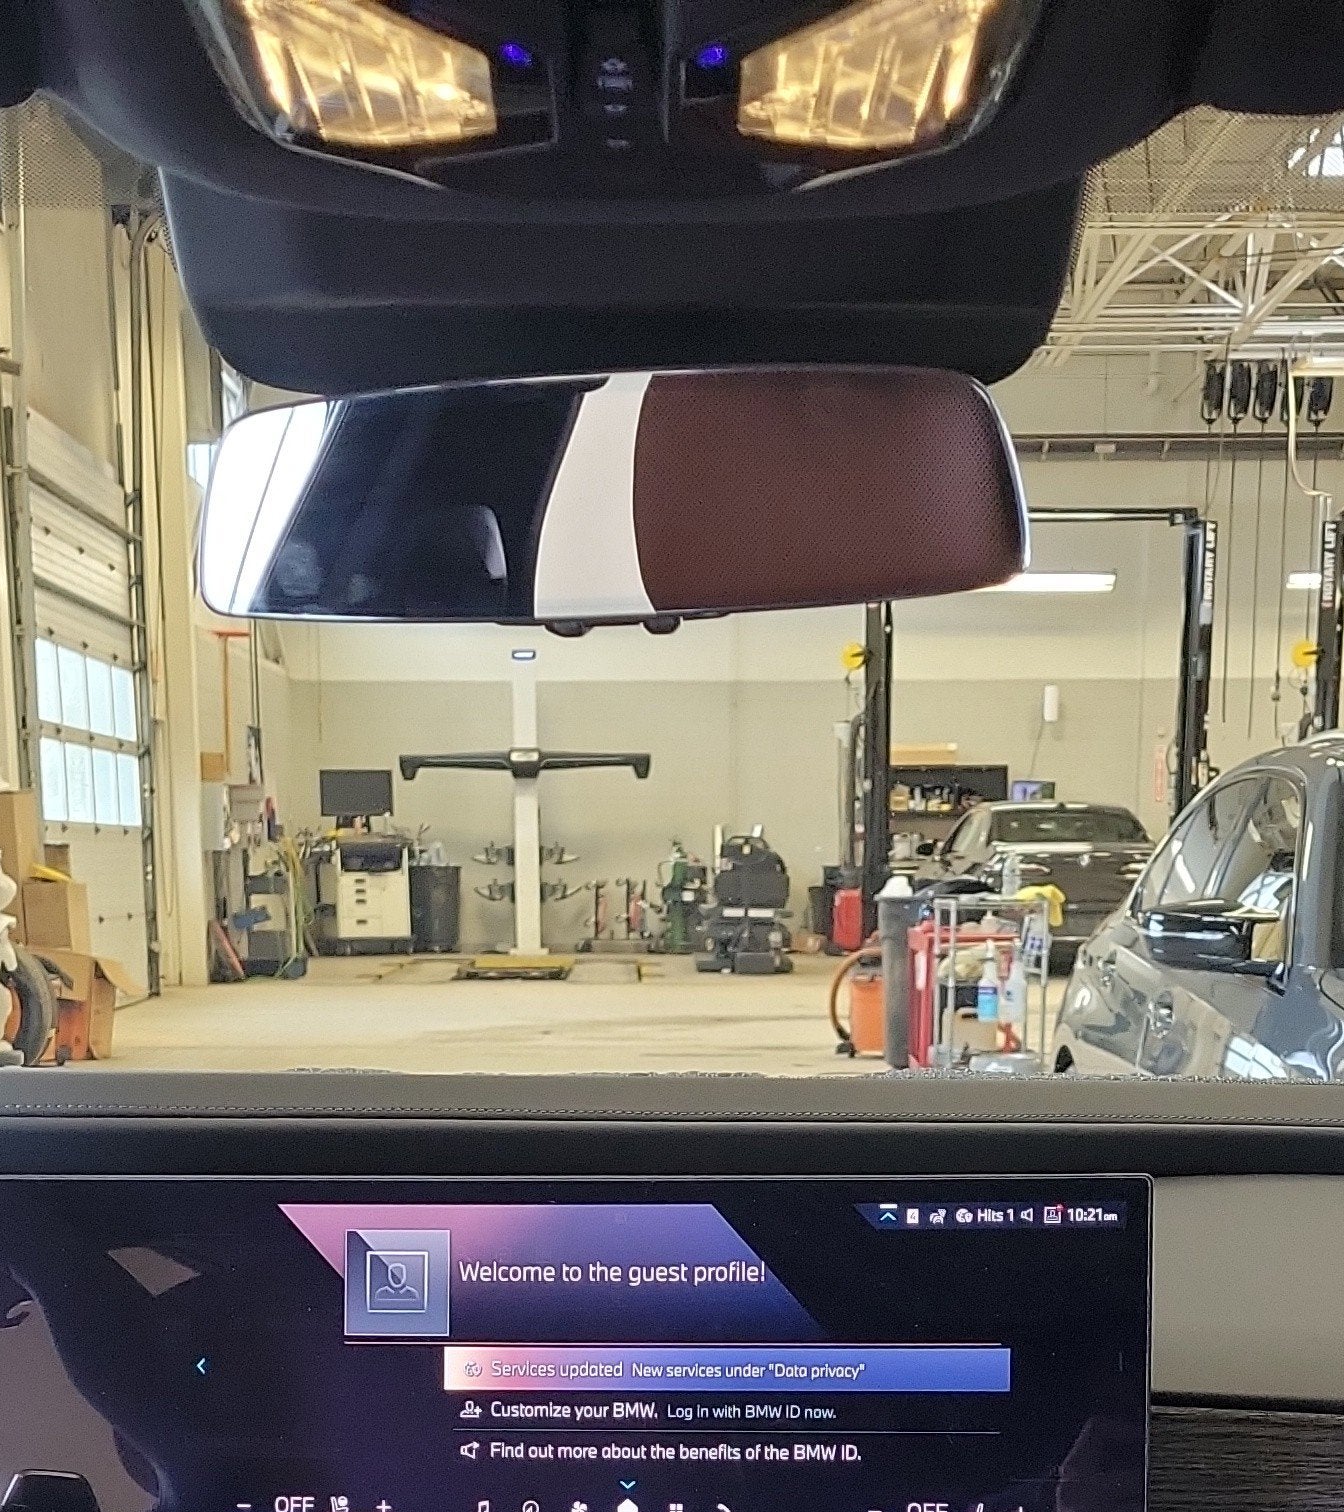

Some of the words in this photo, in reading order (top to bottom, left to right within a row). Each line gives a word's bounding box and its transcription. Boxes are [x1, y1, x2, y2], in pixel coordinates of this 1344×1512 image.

[977, 1209, 1004, 1222] Hits
[1007, 1209, 1014, 1222] 1
[458, 1261, 555, 1282] Welcome
[562, 1262, 582, 1282] to
[588, 1261, 622, 1282] the
[628, 1263, 688, 1286] guest
[694, 1261, 766, 1286] profile!
[491, 1360, 555, 1376] Services
[560, 1361, 623, 1379] updated
[632, 1362, 663, 1378] New
[666, 1363, 722, 1378] services
[725, 1363, 766, 1378] under
[768, 1363, 808, 1378] "Data
[811, 1363, 865, 1381] privacy"
[490, 1401, 571, 1418] Customize
[574, 1405, 609, 1421] your
[612, 1402, 658, 1419] BMW.
[667, 1404, 693, 1420] Log
[697, 1404, 709, 1418] in
[712, 1404, 741, 1419] with
[745, 1405, 782, 1419] BMW
[786, 1405, 801, 1419] ID
[805, 1408, 837, 1419] now.
[490, 1442, 524, 1458] Find
[528, 1444, 554, 1459] out
[558, 1447, 598, 1459] more
[601, 1443, 647, 1460] about
[650, 1444, 675, 1460] the
[679, 1444, 741, 1460] benefits
[745, 1444, 762, 1460] of
[764, 1444, 789, 1460] the
[793, 1444, 836, 1460] BMW
[841, 1445, 862, 1461] ID.
